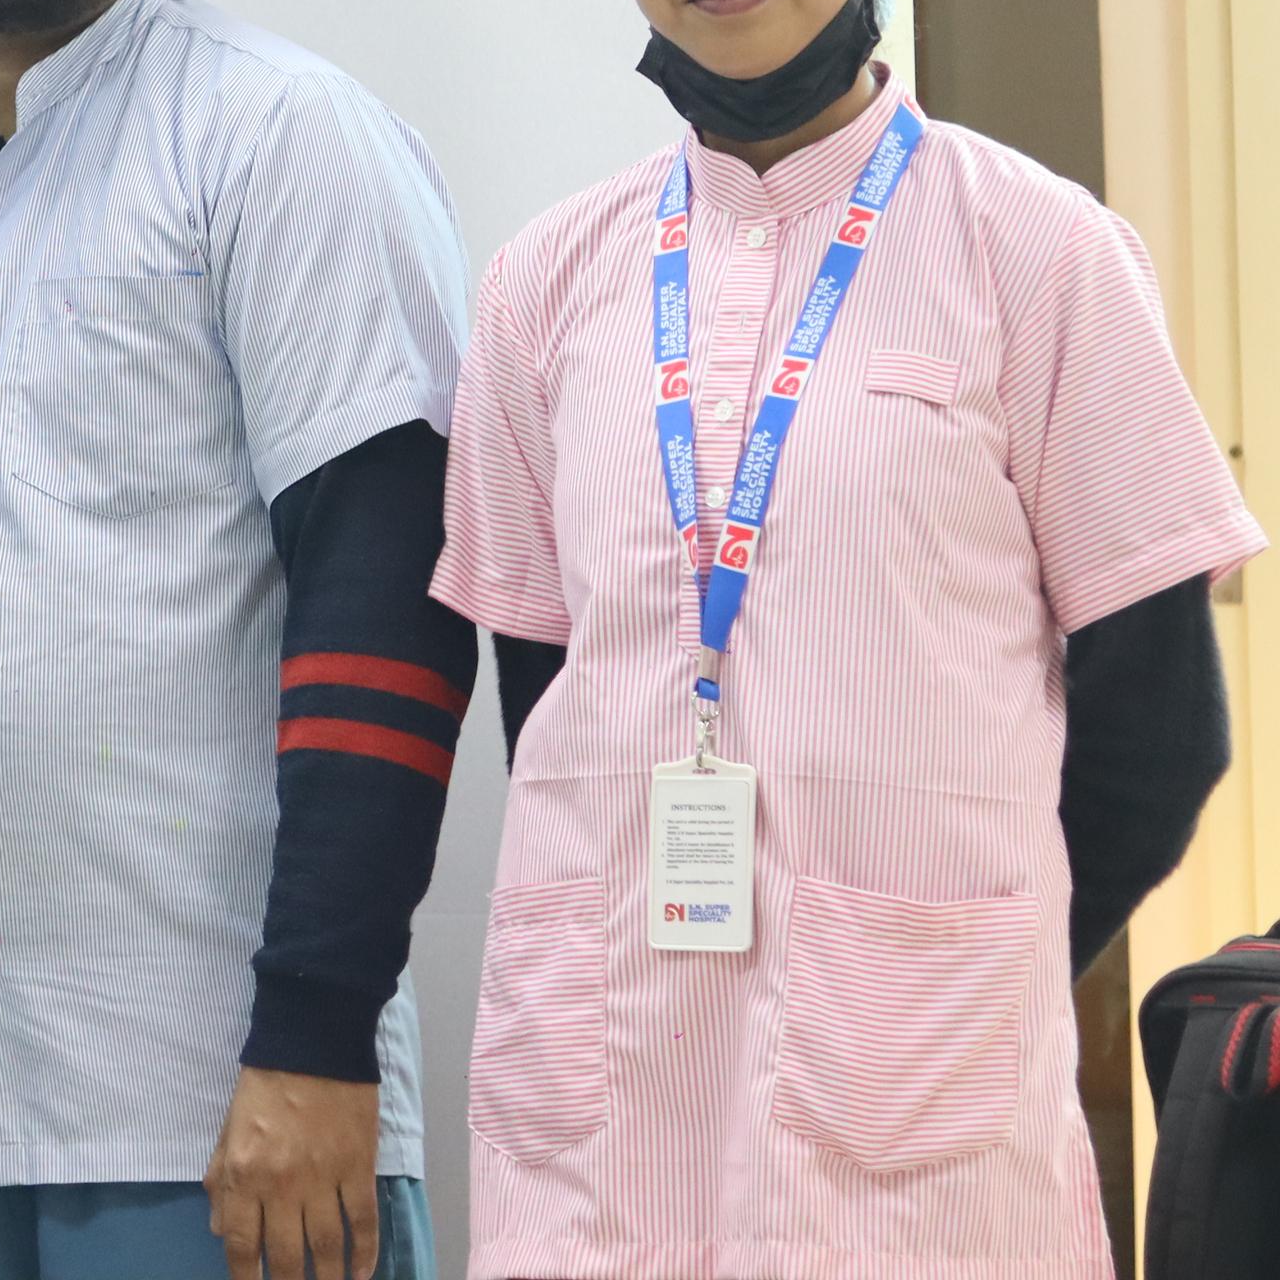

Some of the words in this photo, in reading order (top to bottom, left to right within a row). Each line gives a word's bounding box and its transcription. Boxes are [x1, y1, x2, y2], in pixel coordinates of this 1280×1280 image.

[856, 174, 874, 200] S.N.
[870, 131, 896, 173] SUPER
[864, 132, 904, 202] SPECIALITY
[871, 148, 907, 205] HOSPITAL
[660, 285, 670, 329] SUPER
[668, 281, 678, 356] SPECIALITY
[677, 288, 687, 354] HOSPITAL
[790, 325, 808, 353] S.N.
[802, 277, 826, 323] SUPER
[798, 275, 837, 353] SPECIALITY
[806, 287, 842, 354] HOSPITAL
[660, 331, 670, 358] S.N.
[667, 439, 681, 490] SUPER
[674, 434, 691, 520] SPECIALITY
[684, 442, 696, 517] HOSPITAL
[731, 486, 747, 516] S.N.
[740, 432, 763, 484] SUPER
[740, 430, 772, 519] SPECIALITY
[749, 444, 778, 521] HOSPITAL
[671, 804, 727, 812] INSTRUCTIONS
[688, 910, 732, 918] SPECIALITY
[688, 916, 727, 924] HOSPITAL
[705, 903, 731, 911] SUPER
